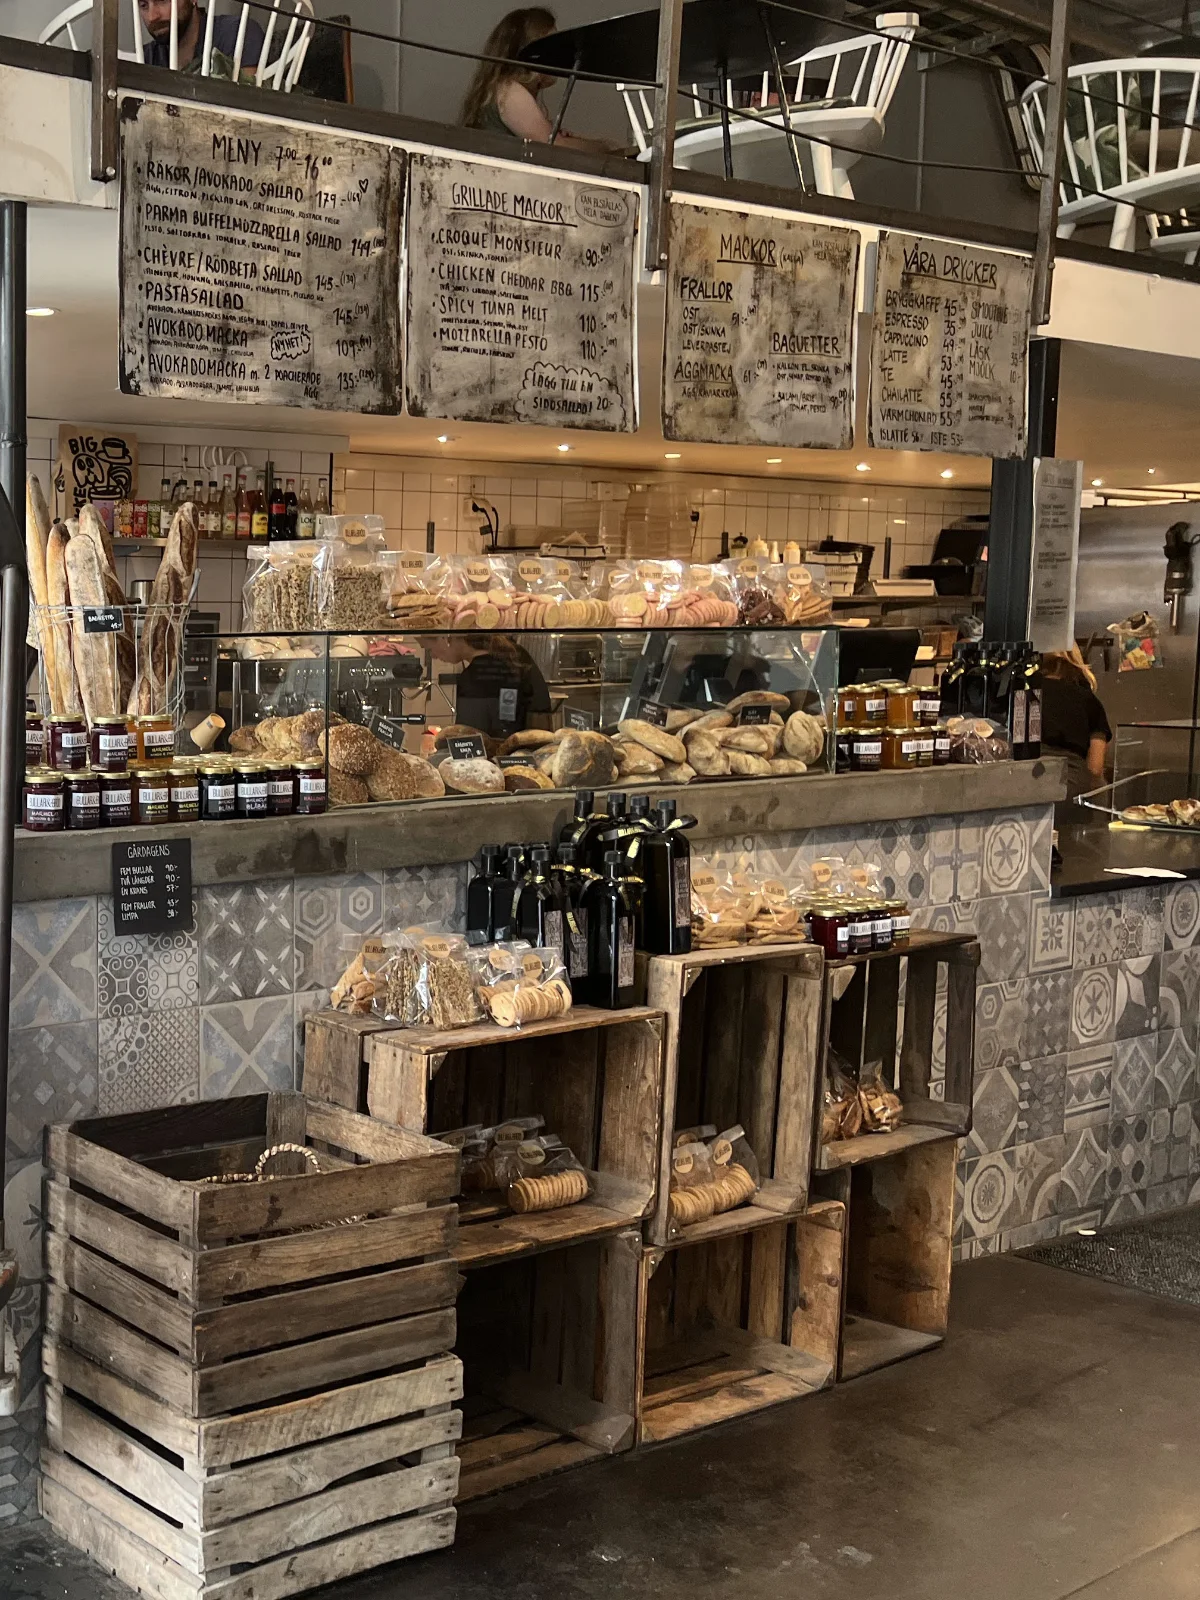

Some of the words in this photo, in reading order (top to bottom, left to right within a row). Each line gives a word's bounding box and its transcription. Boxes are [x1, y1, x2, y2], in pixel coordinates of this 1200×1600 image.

[212, 133, 261, 167] MENY
[147, 160, 253, 192] RÄKOR/AVOKADO
[259, 182, 303, 203] SALLAD
[452, 182, 508, 213] GRILLADE
[513, 195, 564, 223] MACKOR
[146, 203, 187, 224] PARMA
[306, 231, 341, 251] SALLAD
[439, 228, 487, 248] CROQUE
[495, 234, 561, 260] MONSIEUR
[720, 233, 775, 264] MACKOR
[144, 244, 257, 279] CHÈVRE/RÖDBETA
[263, 265, 302, 285] SALLAD
[903, 243, 936, 275] VÅRA
[944, 255, 997, 289] DRYCKER
[438, 262, 495, 283] CHICKEN
[501, 270, 545, 292] CHEDDAR
[550, 280, 572, 297] BBQ
[681, 277, 733, 301] FRALLOR
[146, 281, 244, 310] PASTASALLAD
[885, 289, 941, 313] BRYGGKAFFE
[440, 294, 474, 314] SPICY
[481, 300, 515, 316] TUNA
[522, 304, 548, 322] MELT
[683, 306, 699, 320] OST
[148, 316, 202, 341] AVOKADO
[207, 324, 247, 348] MACKA
[884, 329, 928, 347] CAPPUCCINO
[885, 312, 928, 330] ESPRESSO
[971, 322, 993, 340] JUICE
[274, 336, 303, 352] NYHET!
[440, 327, 511, 345] MOZZARELLA
[515, 332, 548, 351] PESTO
[682, 340, 731, 354] LEVERPASTEJ
[773, 332, 840, 354] BAGUETTER
[674, 355, 734, 382] ÄGGMACKA
[883, 349, 907, 364] LATTE
[148, 353, 246, 380] AVOKADOMACKA
[265, 363, 271, 380] 2
[275, 369, 321, 385] POACHERADE
[880, 366, 894, 381] TE
[533, 372, 556, 390] LÄGG
[561, 378, 577, 392] TILL
[68, 436, 97, 455] BIG
[880, 428, 908, 443] ISLATTE
[931, 431, 947, 446] ISTE
[127, 844, 170, 858] GÅRDAGENS
[120, 867, 131, 875] FEM
[132, 865, 153, 875] BULLAR
[129, 886, 148, 895] KRANS
[121, 902, 132, 911] FEM
[133, 900, 156, 910] FRALLOR
[122, 912, 139, 920] LIMPA
